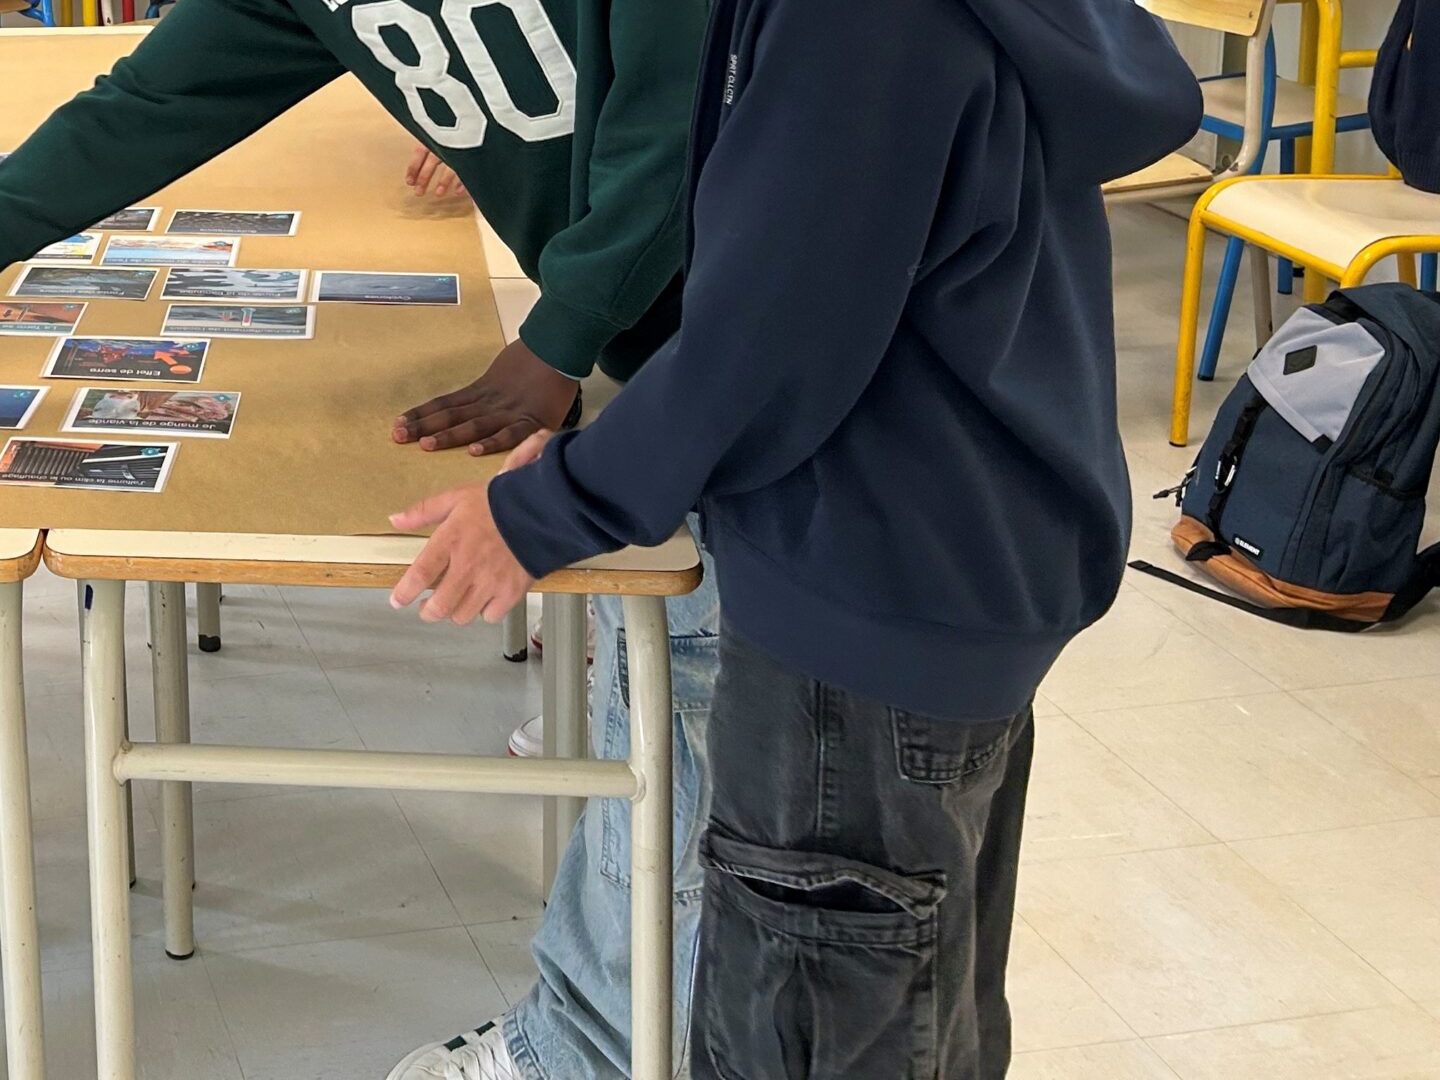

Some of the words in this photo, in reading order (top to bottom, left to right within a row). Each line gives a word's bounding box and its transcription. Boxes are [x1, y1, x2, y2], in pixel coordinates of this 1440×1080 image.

[119, 368, 134, 376] de
[136, 369, 161, 377] Effet
[1, 473, 48, 481] chauffage
